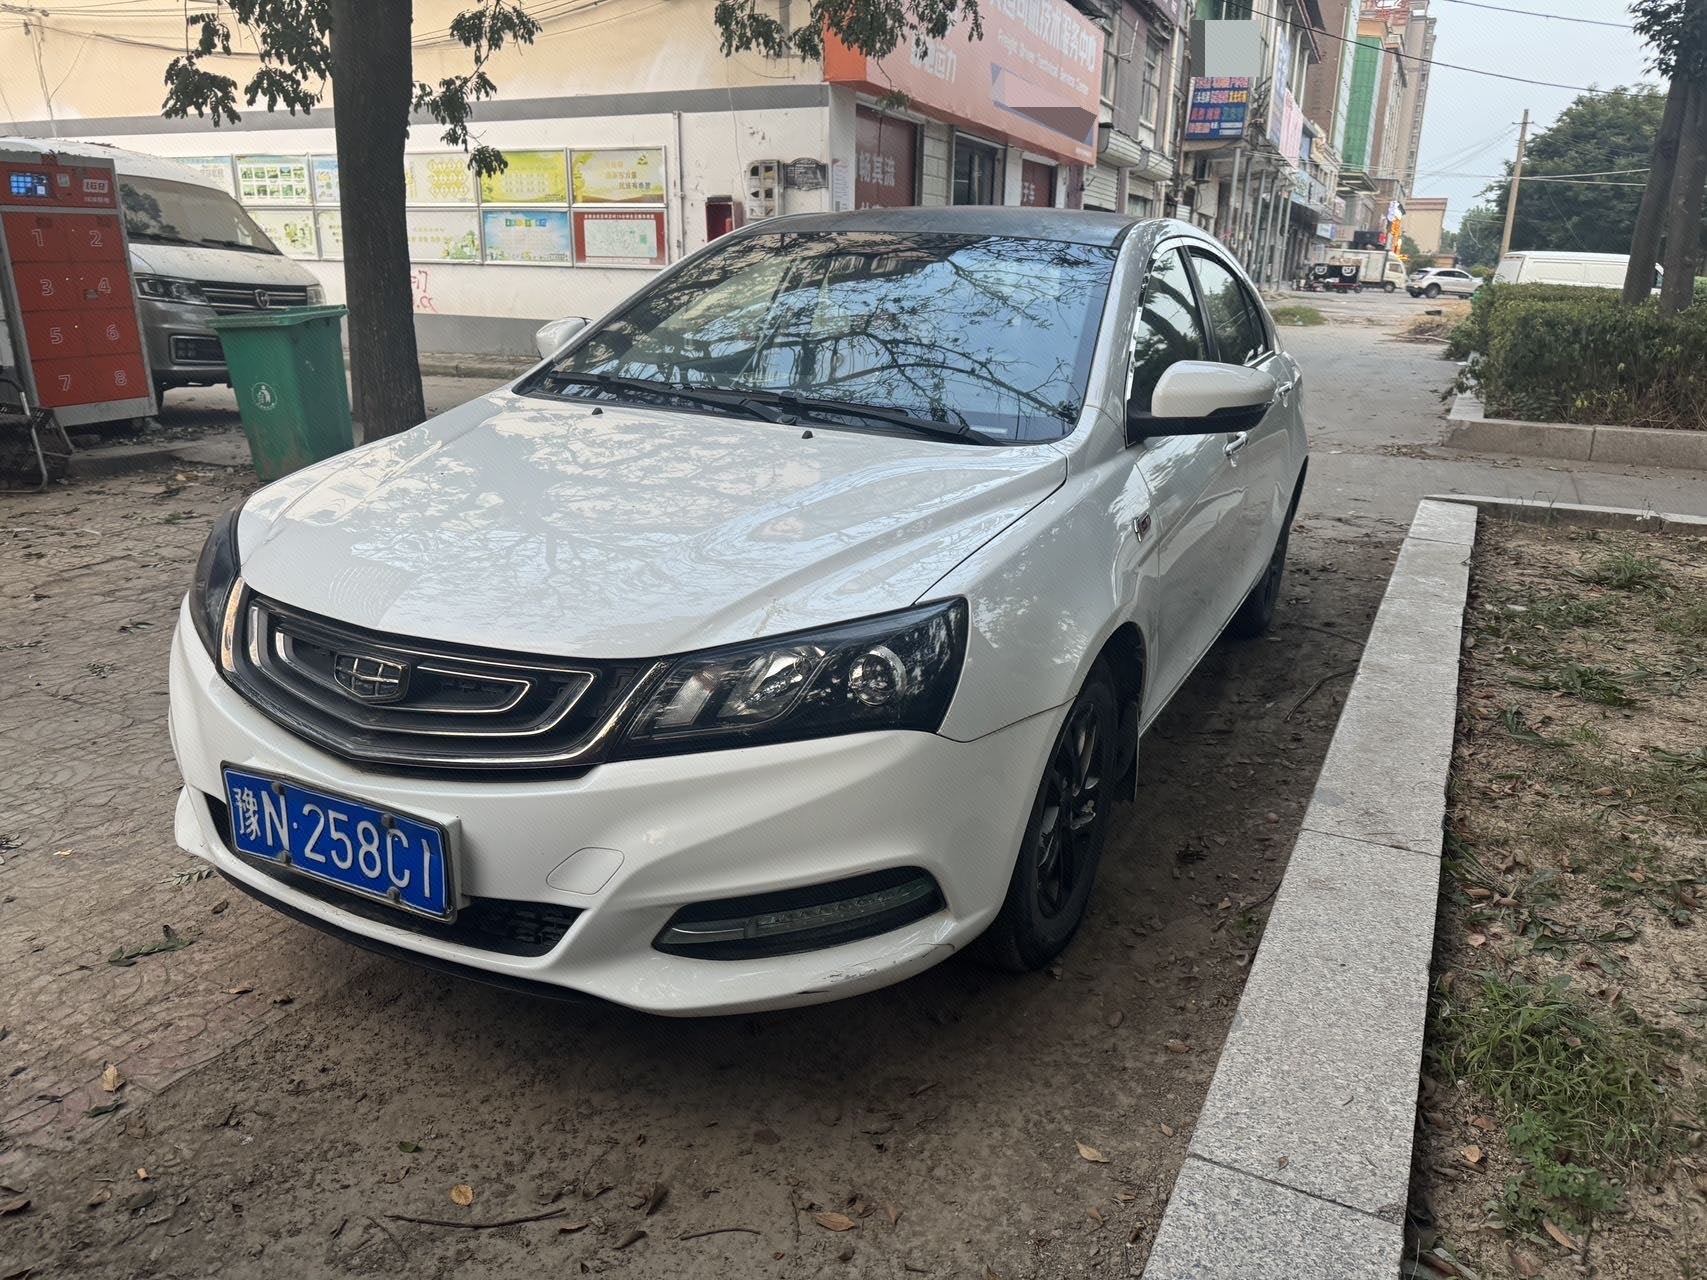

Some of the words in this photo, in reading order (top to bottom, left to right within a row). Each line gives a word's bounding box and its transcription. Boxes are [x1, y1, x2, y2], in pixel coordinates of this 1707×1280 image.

[32, 229, 44, 247] 1
[89, 231, 103, 247] 2
[40, 279, 54, 296] 3
[98, 277, 111, 294] 4
[51, 327, 64, 344] 5
[106, 324, 119, 341] 6
[58, 374, 71, 391] 7
[114, 370, 127, 386] 8
[232, 786, 431, 899] 豫N·258C1
